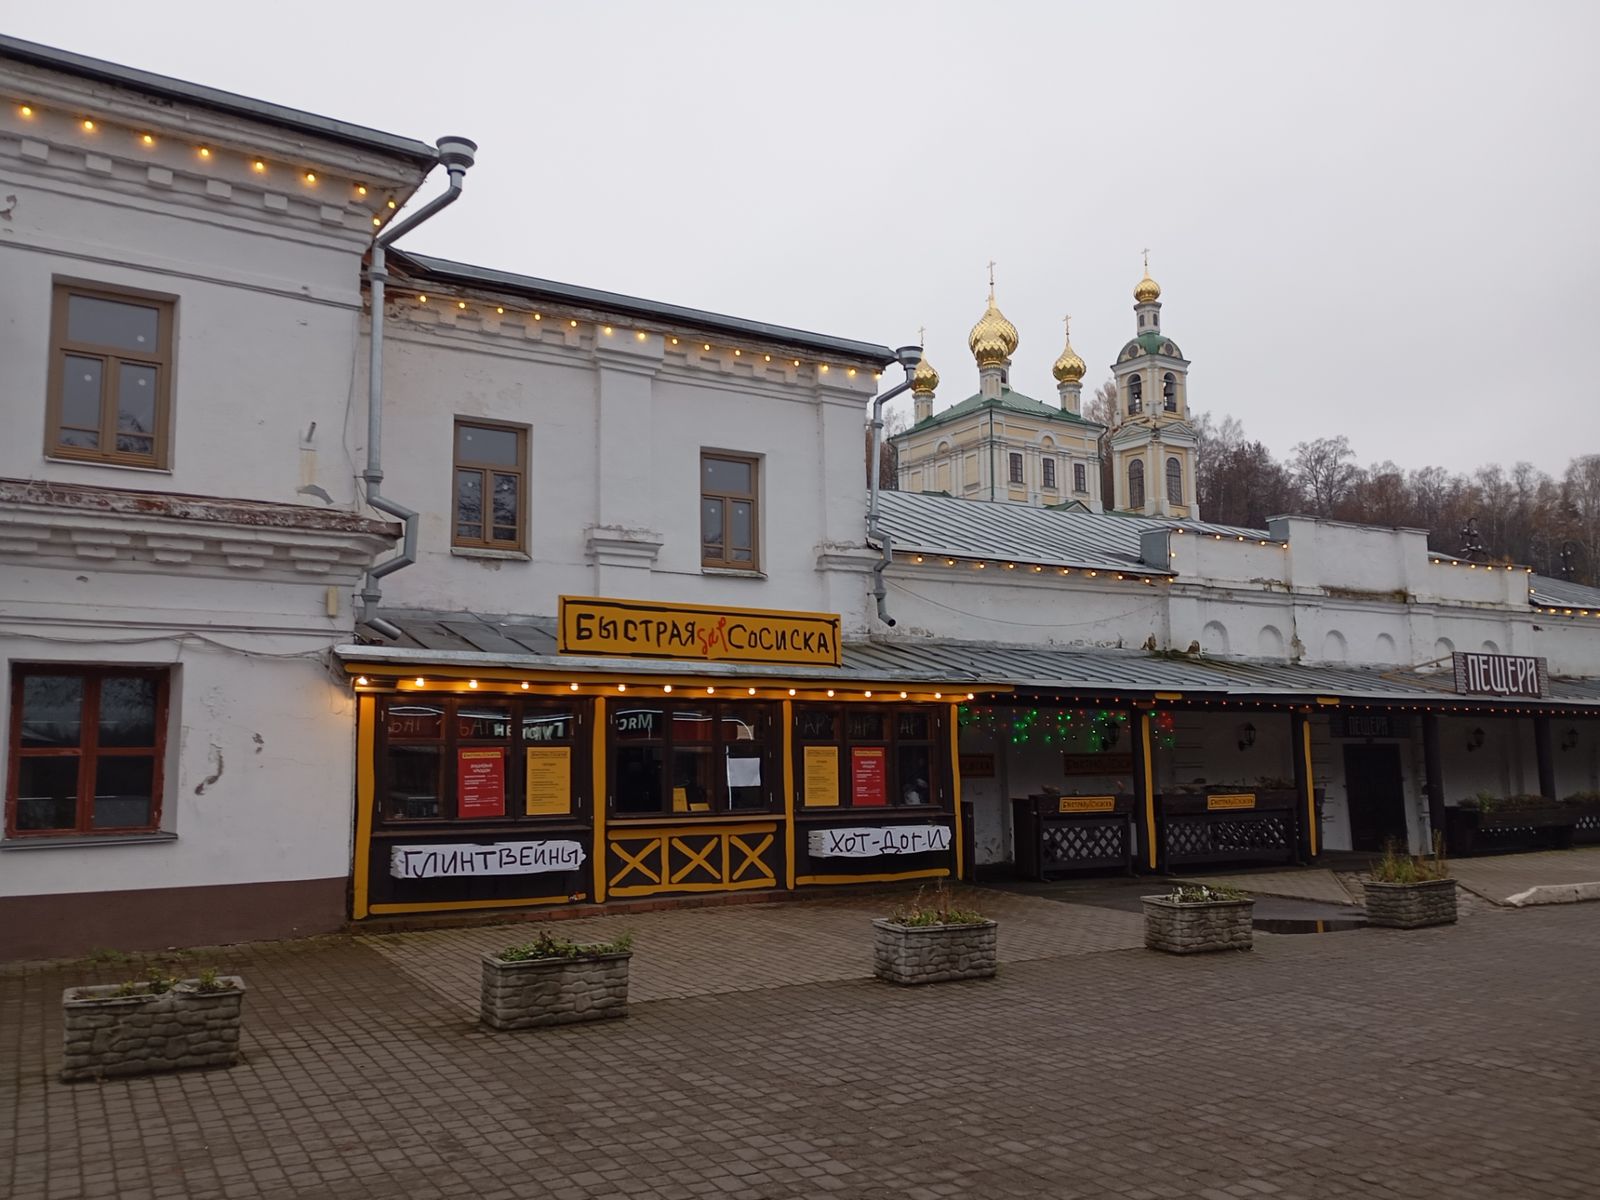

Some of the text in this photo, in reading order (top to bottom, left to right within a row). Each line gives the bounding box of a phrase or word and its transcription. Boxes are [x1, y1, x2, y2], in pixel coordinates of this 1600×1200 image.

[575, 613, 696, 648] БЫСТРАЯ
[1466, 654, 1539, 695] ПЕЩЕРА
[403, 839, 579, 878] ГЛИНТВЕЙНЫ
